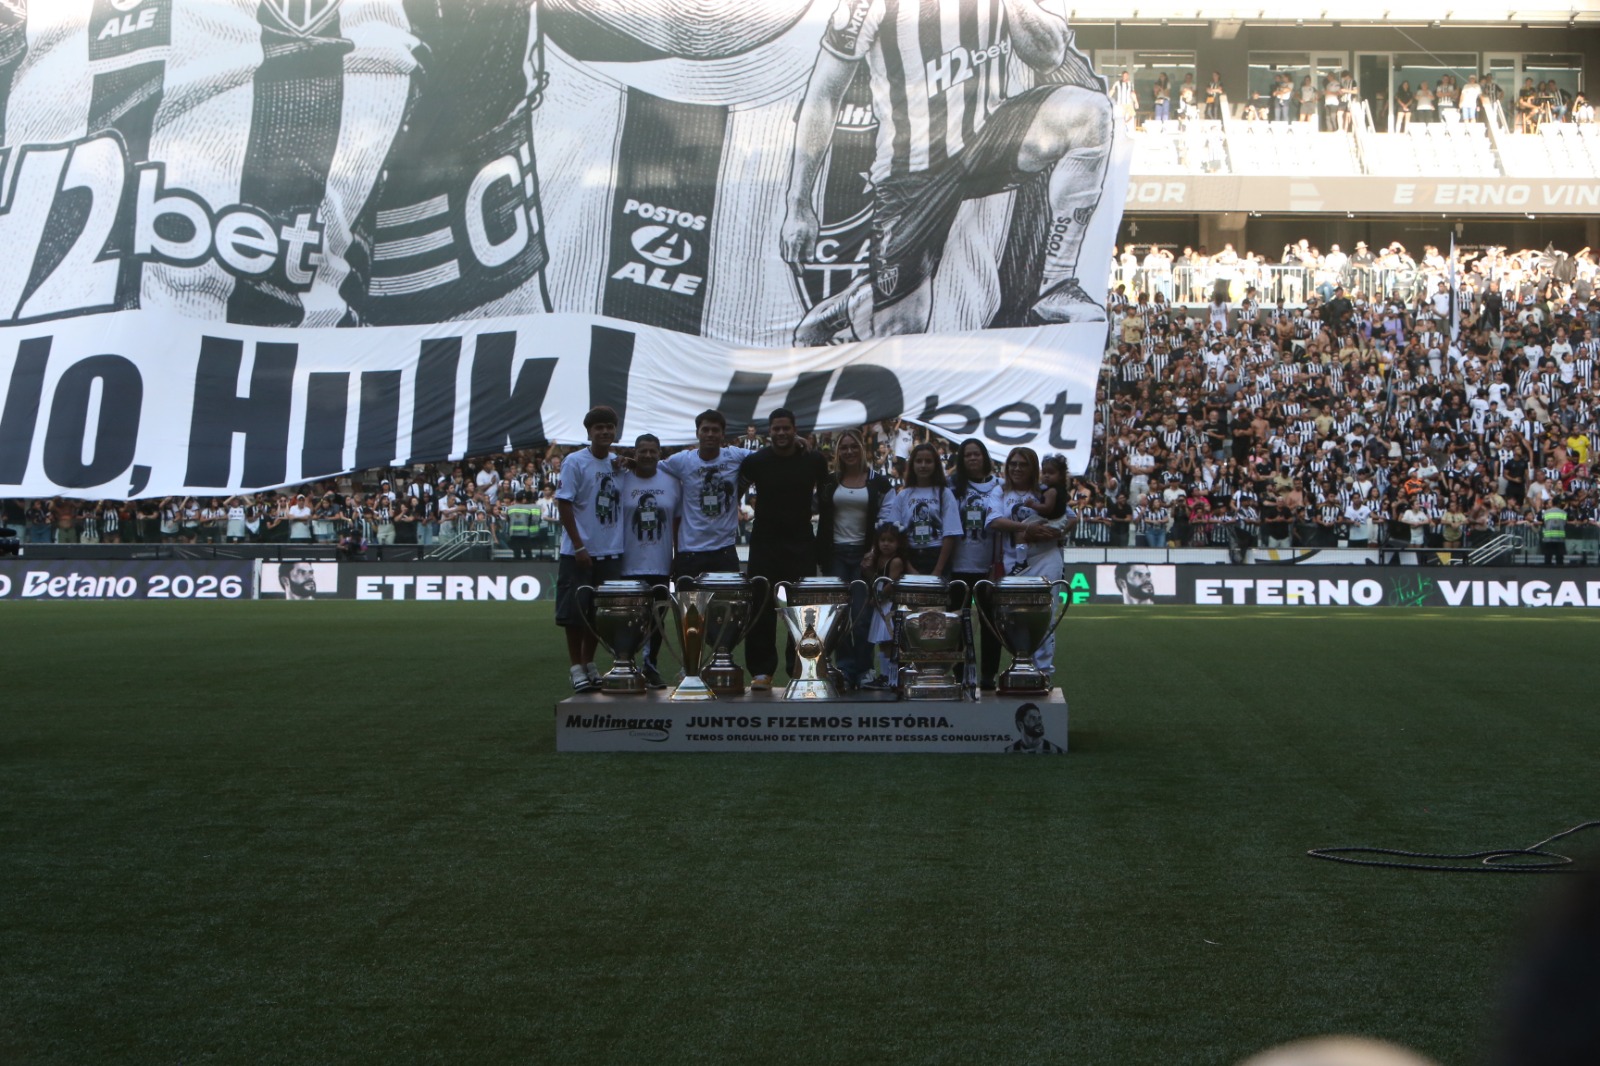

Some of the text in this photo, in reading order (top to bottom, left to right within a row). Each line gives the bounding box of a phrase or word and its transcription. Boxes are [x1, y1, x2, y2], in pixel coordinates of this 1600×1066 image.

[97, 7, 158, 41] ALE
[925, 39, 1011, 98] H2bet
[623, 198, 707, 231] POSTOS
[611, 261, 703, 296] ALE
[21, 571, 137, 599] Betano
[147, 575, 243, 599] 2026
[355, 575, 542, 601] ETERNO
[1195, 578, 1383, 607] ETERNO
[566, 714, 673, 730] Multimarcas
[686, 713, 954, 728] JUNTOS FIZEMOS HISTÓRIA.
[685, 734, 1014, 742] TEMOS ORGULHO DE TER FEITO PARTE DESSAS CONQUISTAS.
